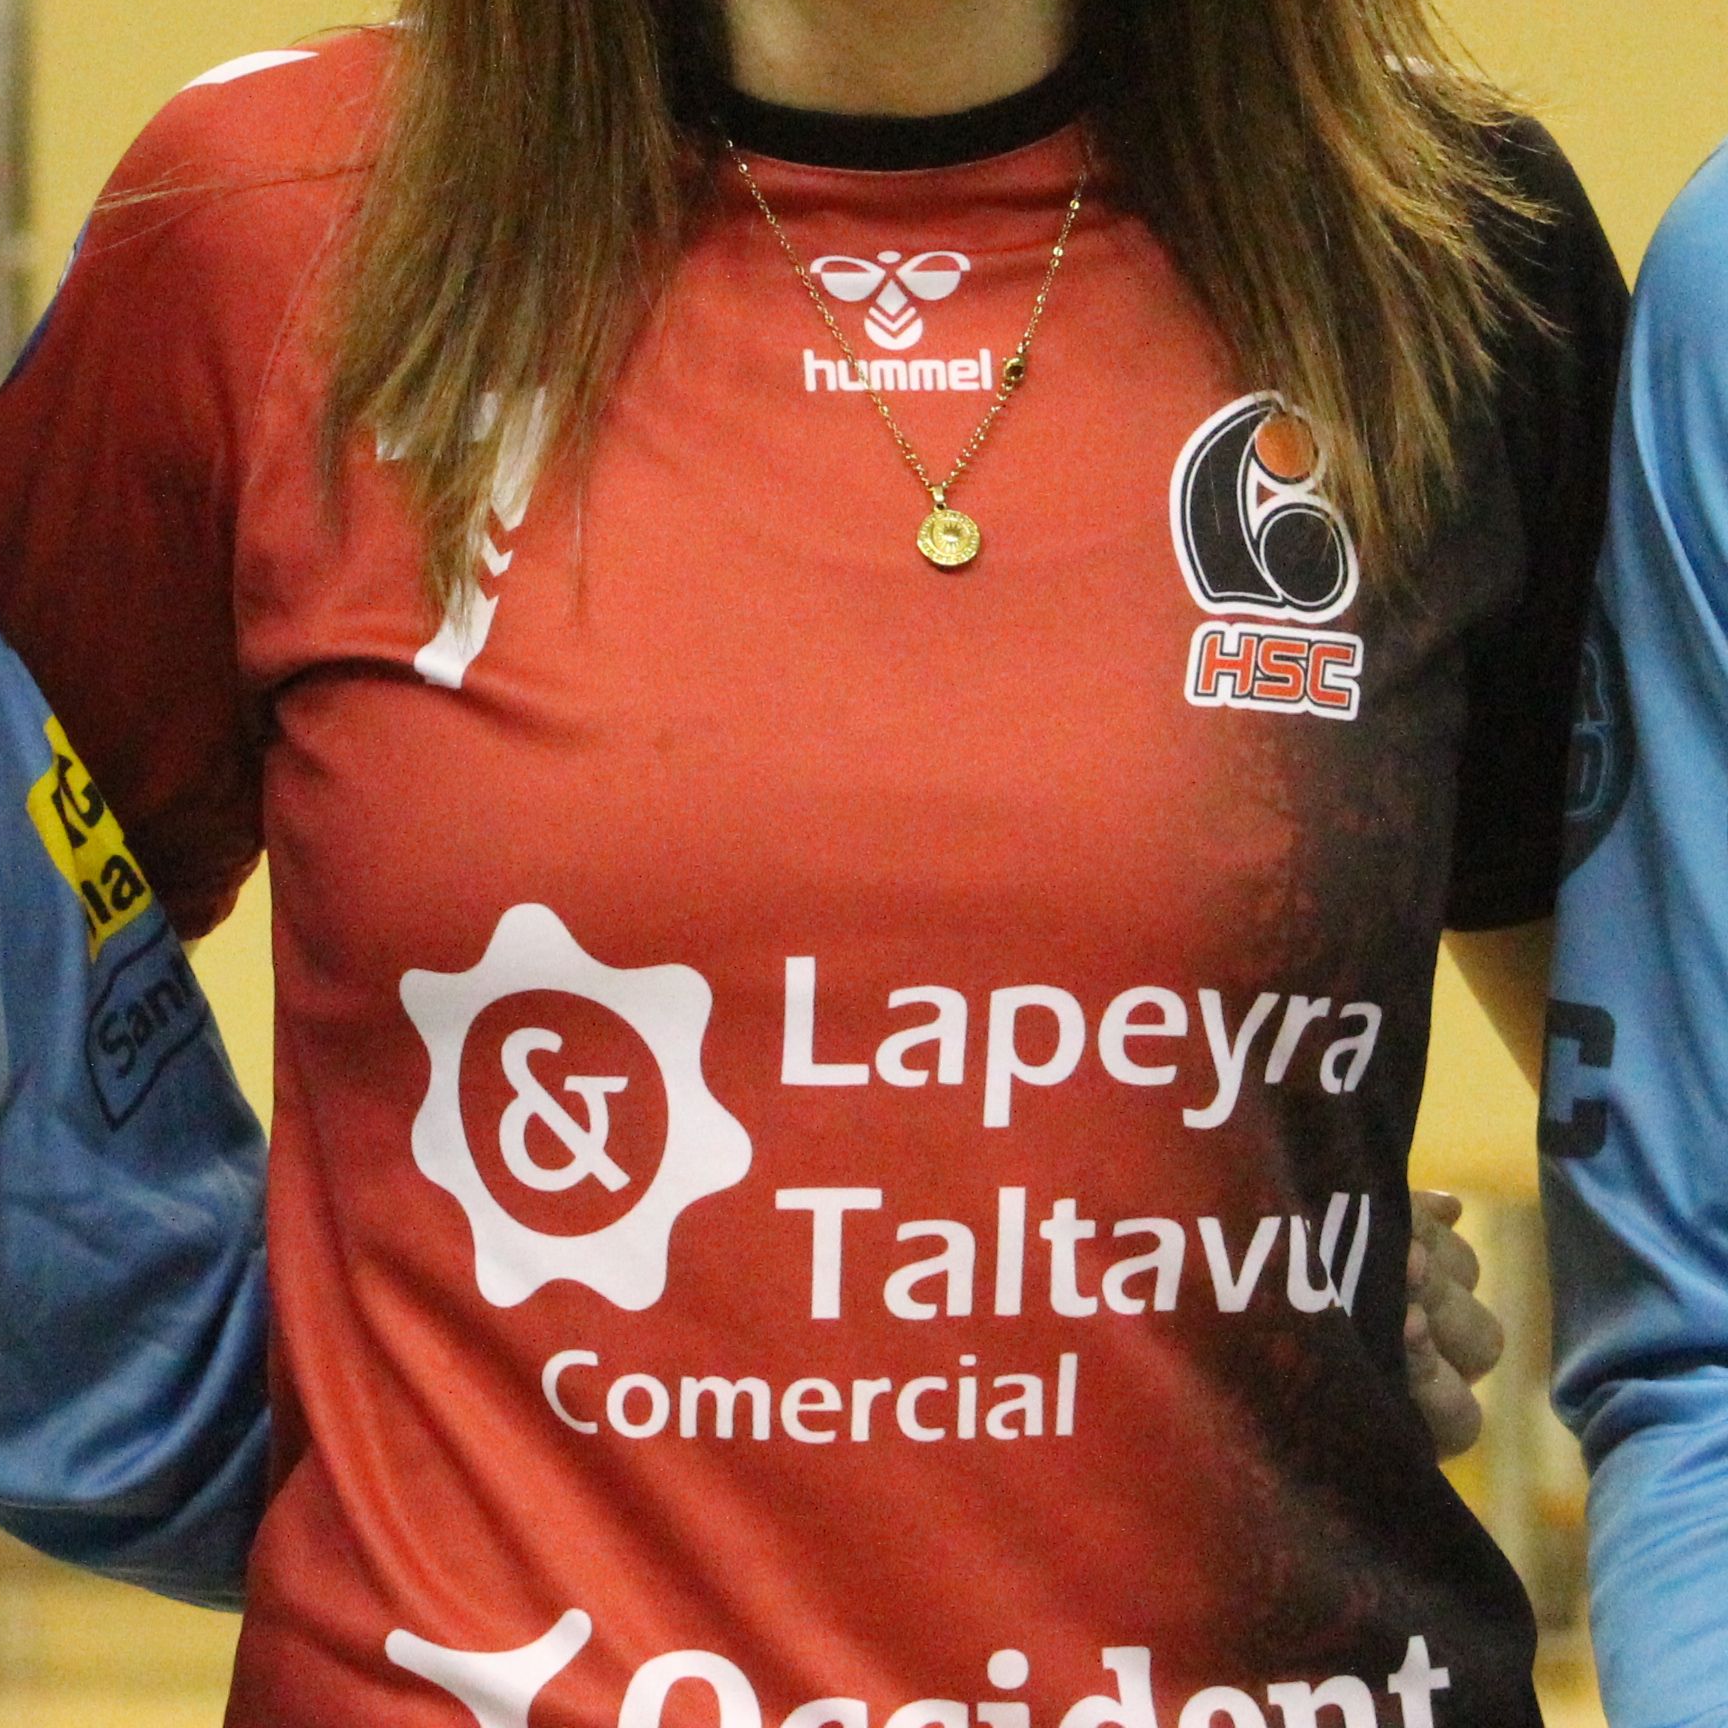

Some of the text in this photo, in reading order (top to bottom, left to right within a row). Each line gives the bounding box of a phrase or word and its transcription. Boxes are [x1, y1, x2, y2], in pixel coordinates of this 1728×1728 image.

[802, 347, 993, 393] hummel
[1194, 630, 1356, 712] HSC
[780, 955, 1383, 1131] Lapeyra
[498, 1027, 631, 1193] &
[774, 1186, 1371, 1320] Taltavull
[540, 1348, 1080, 1444] Comercial
[617, 1634, 1451, 1728] Oidt
